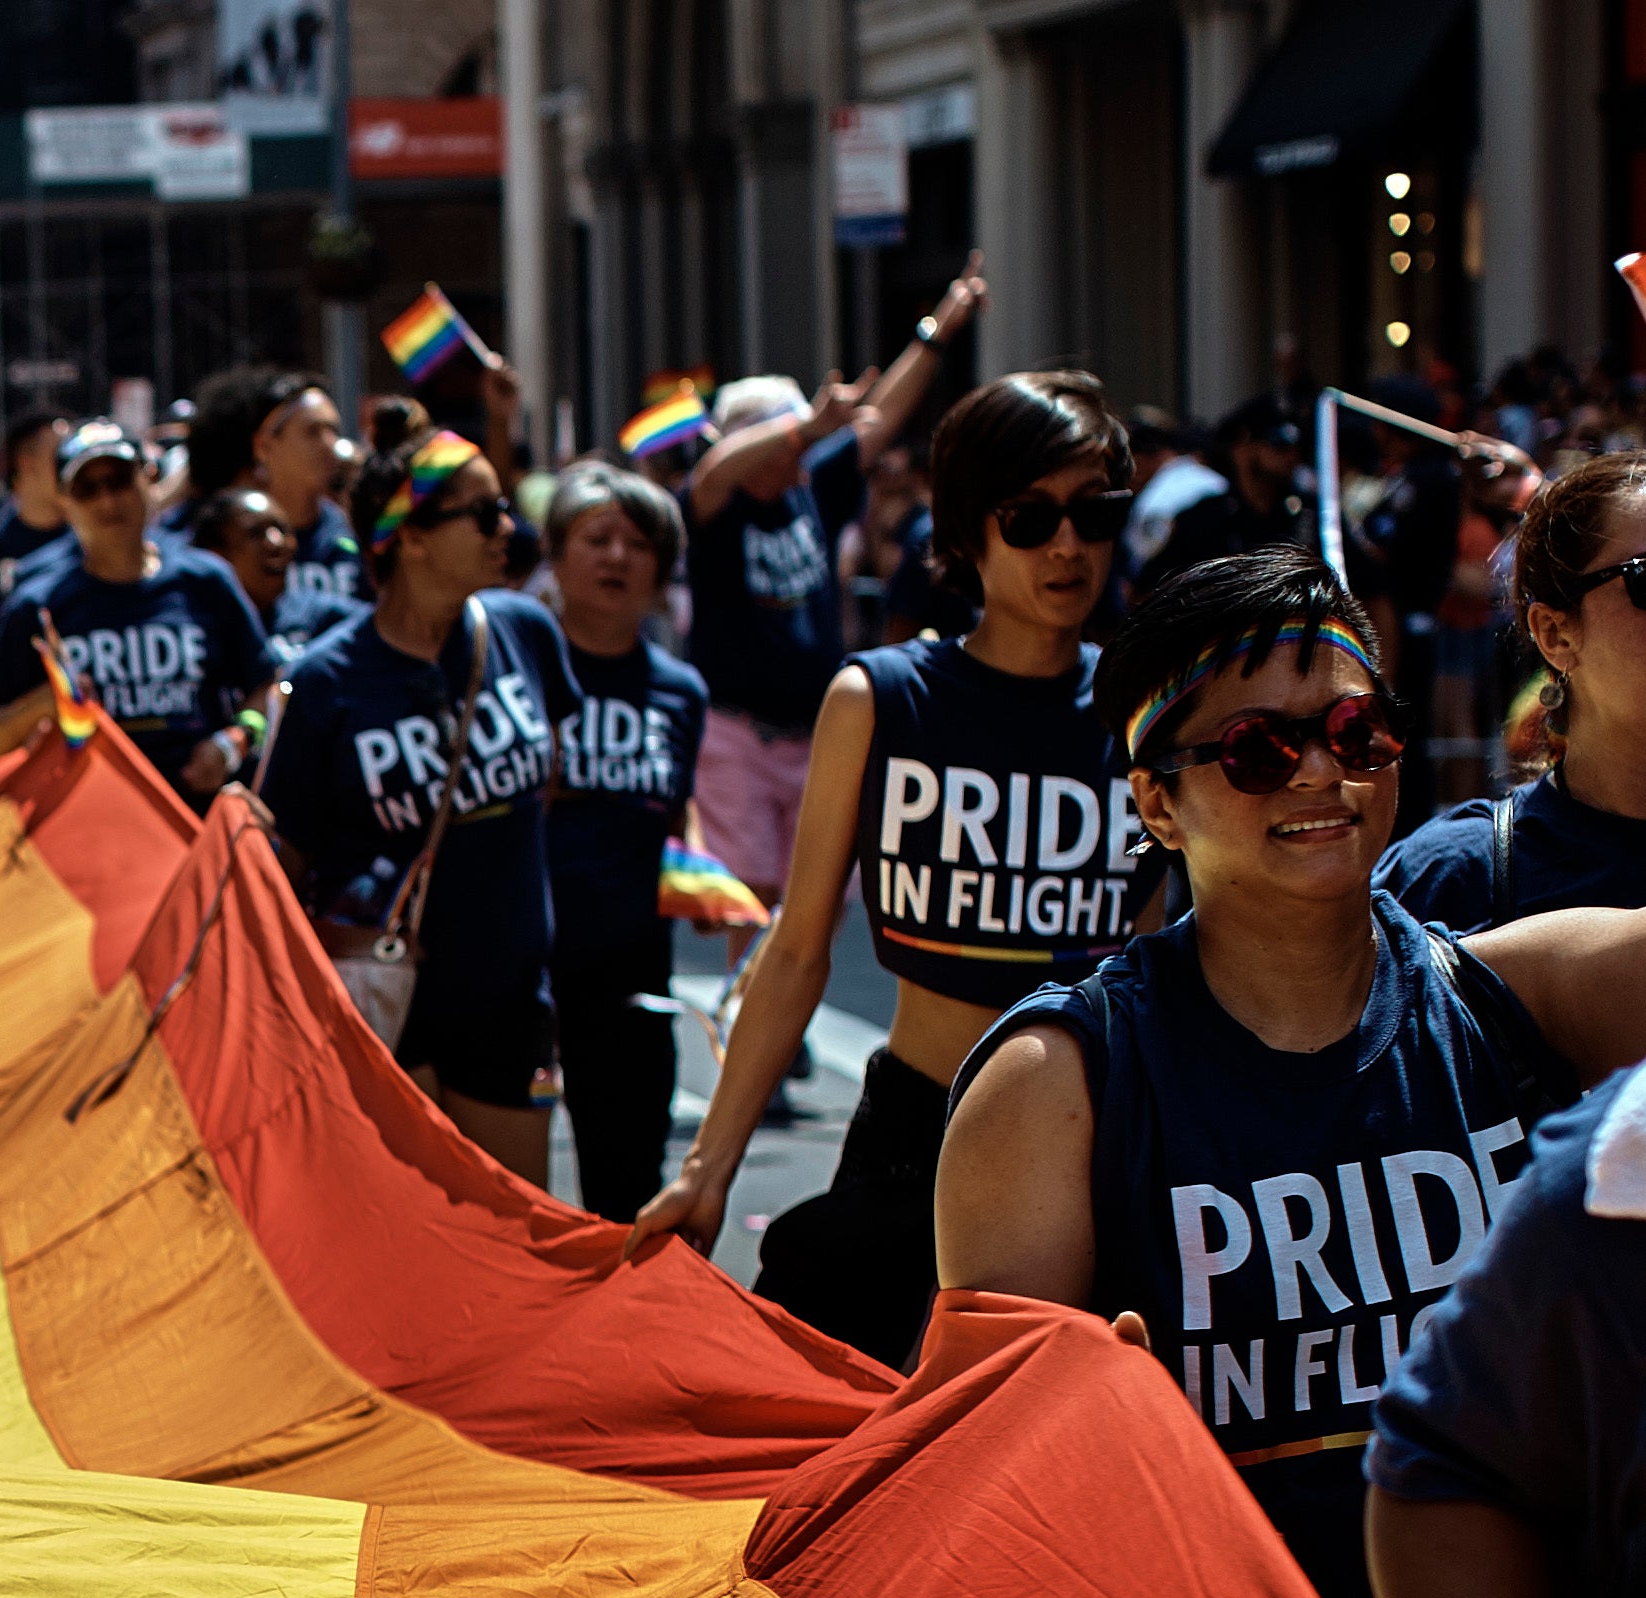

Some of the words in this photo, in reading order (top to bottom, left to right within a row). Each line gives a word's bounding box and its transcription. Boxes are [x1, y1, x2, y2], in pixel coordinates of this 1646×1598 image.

[286, 561, 360, 600] IDE
[62, 623, 206, 685] PRIDE
[566, 747, 674, 797] LIGHT
[879, 756, 1145, 873] PRIDE
[879, 857, 932, 925] IN
[946, 869, 1134, 937] FLIGHT.
[1170, 1116, 1525, 1330] PRIDE
[1182, 1338, 1266, 1426] IN
